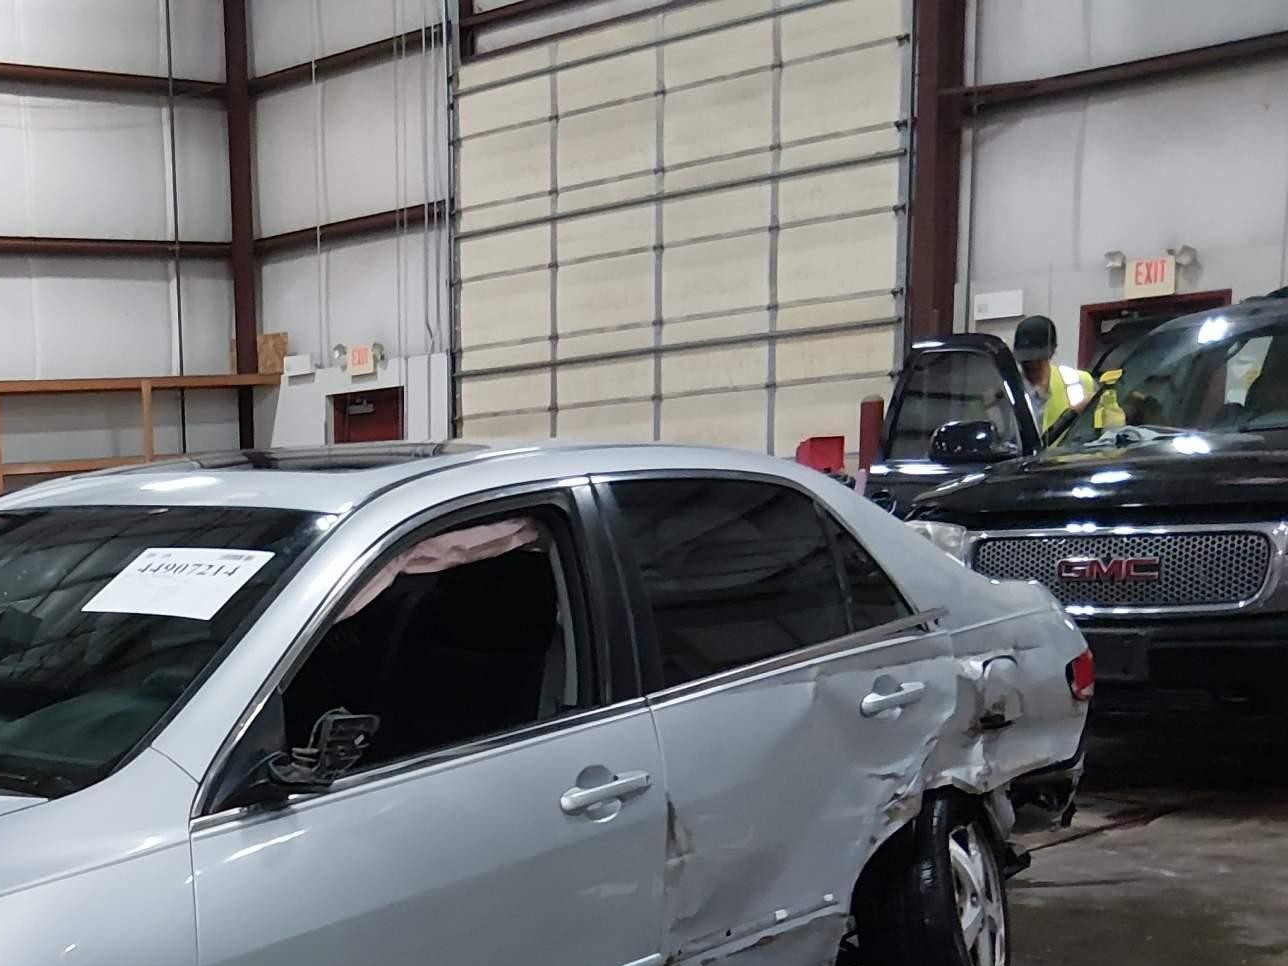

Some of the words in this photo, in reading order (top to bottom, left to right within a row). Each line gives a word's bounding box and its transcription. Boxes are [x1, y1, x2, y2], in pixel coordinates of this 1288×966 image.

[1135, 259, 1167, 285] EXIT
[351, 347, 368, 366] EXIT
[137, 563, 241, 577] 44907214
[1056, 556, 1161, 582] GMC
